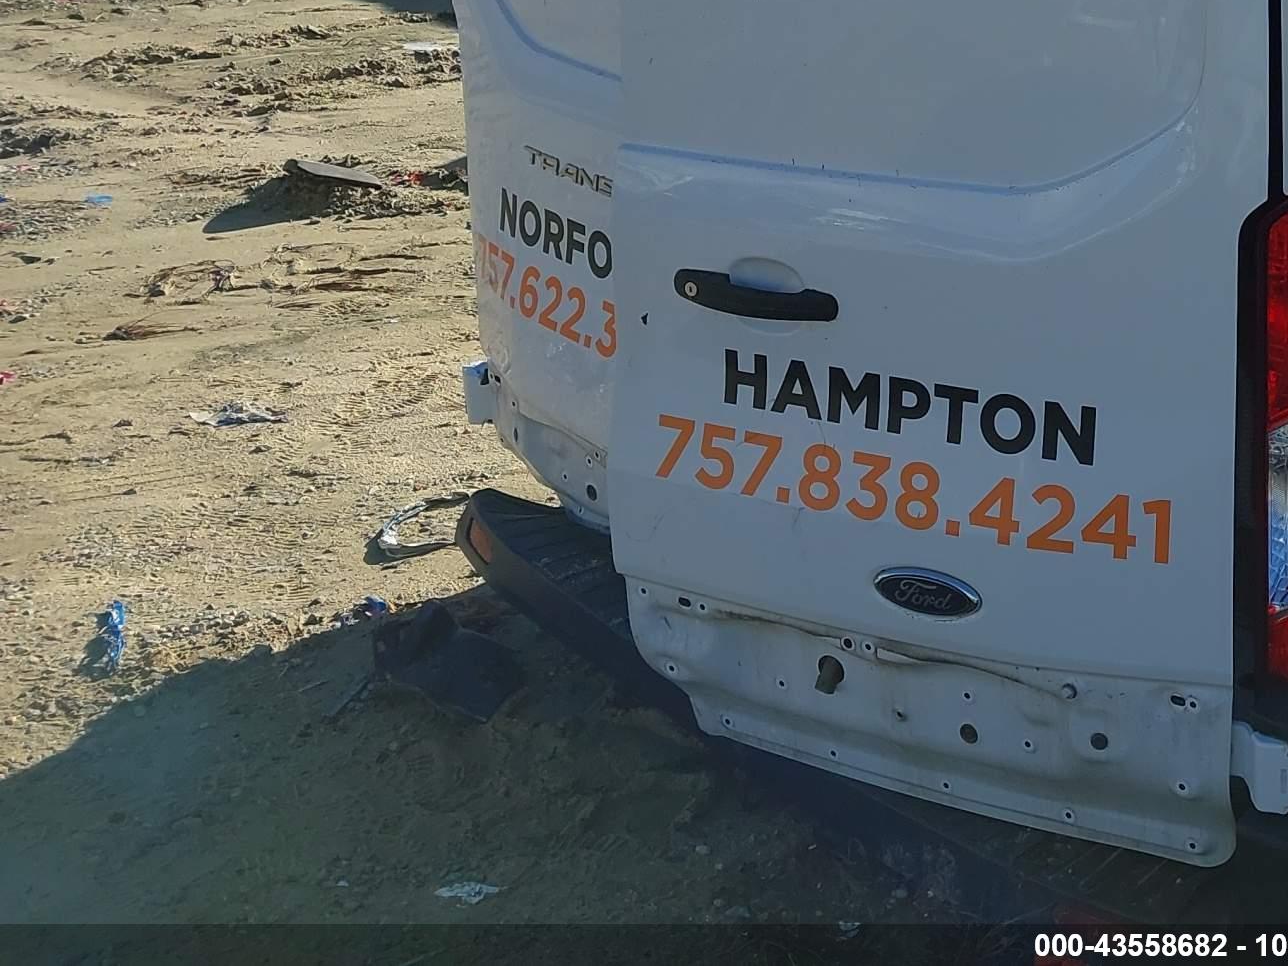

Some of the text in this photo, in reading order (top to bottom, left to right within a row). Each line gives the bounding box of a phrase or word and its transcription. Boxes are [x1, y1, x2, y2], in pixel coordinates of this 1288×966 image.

[500, 187, 613, 279] NORFO
[723, 348, 1098, 467] HAMPTON
[655, 413, 1173, 565] 757.838.4241
[895, 579, 953, 611] Ford
